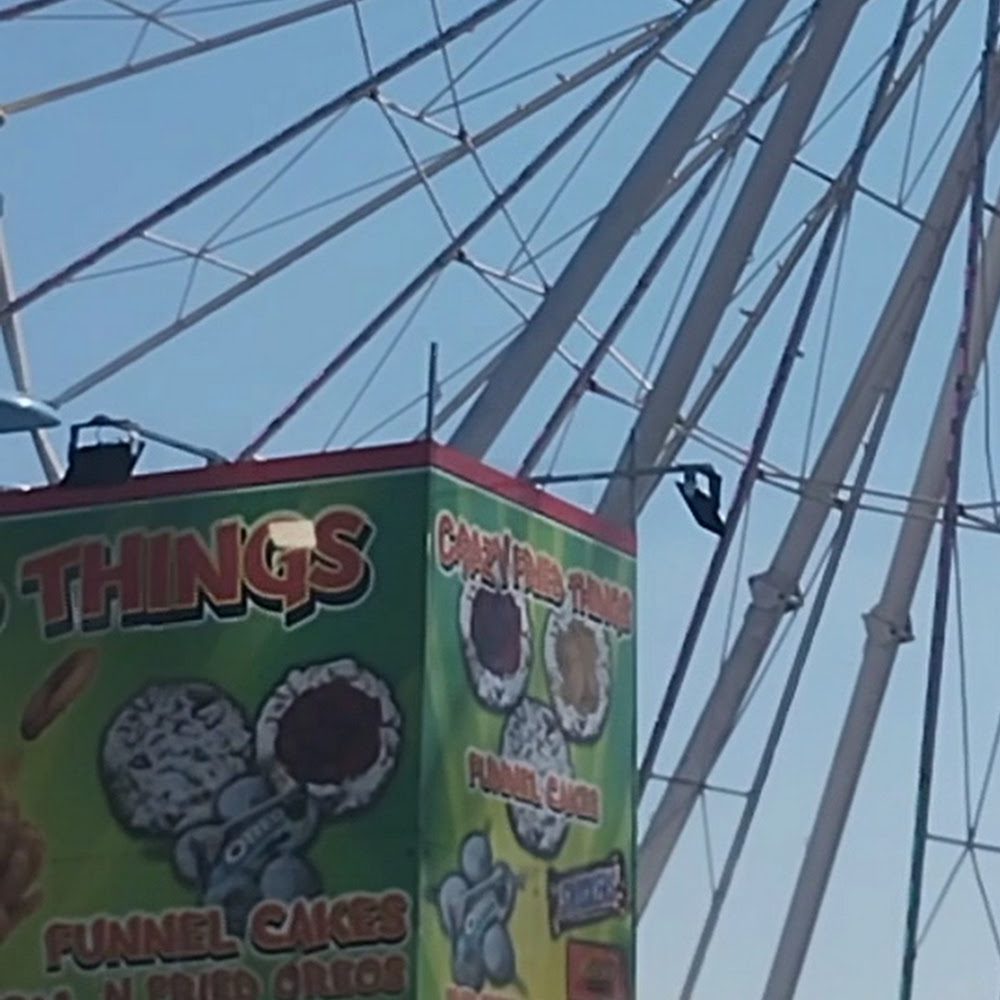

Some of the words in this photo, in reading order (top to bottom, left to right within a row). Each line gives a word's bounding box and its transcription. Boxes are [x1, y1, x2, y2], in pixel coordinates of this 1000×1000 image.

[18, 506, 374, 633] THINGS
[44, 908, 240, 973] FUNNEL
[250, 892, 410, 953] CAKES
[146, 969, 261, 1000] FRIED
[274, 954, 406, 998] OREOS
